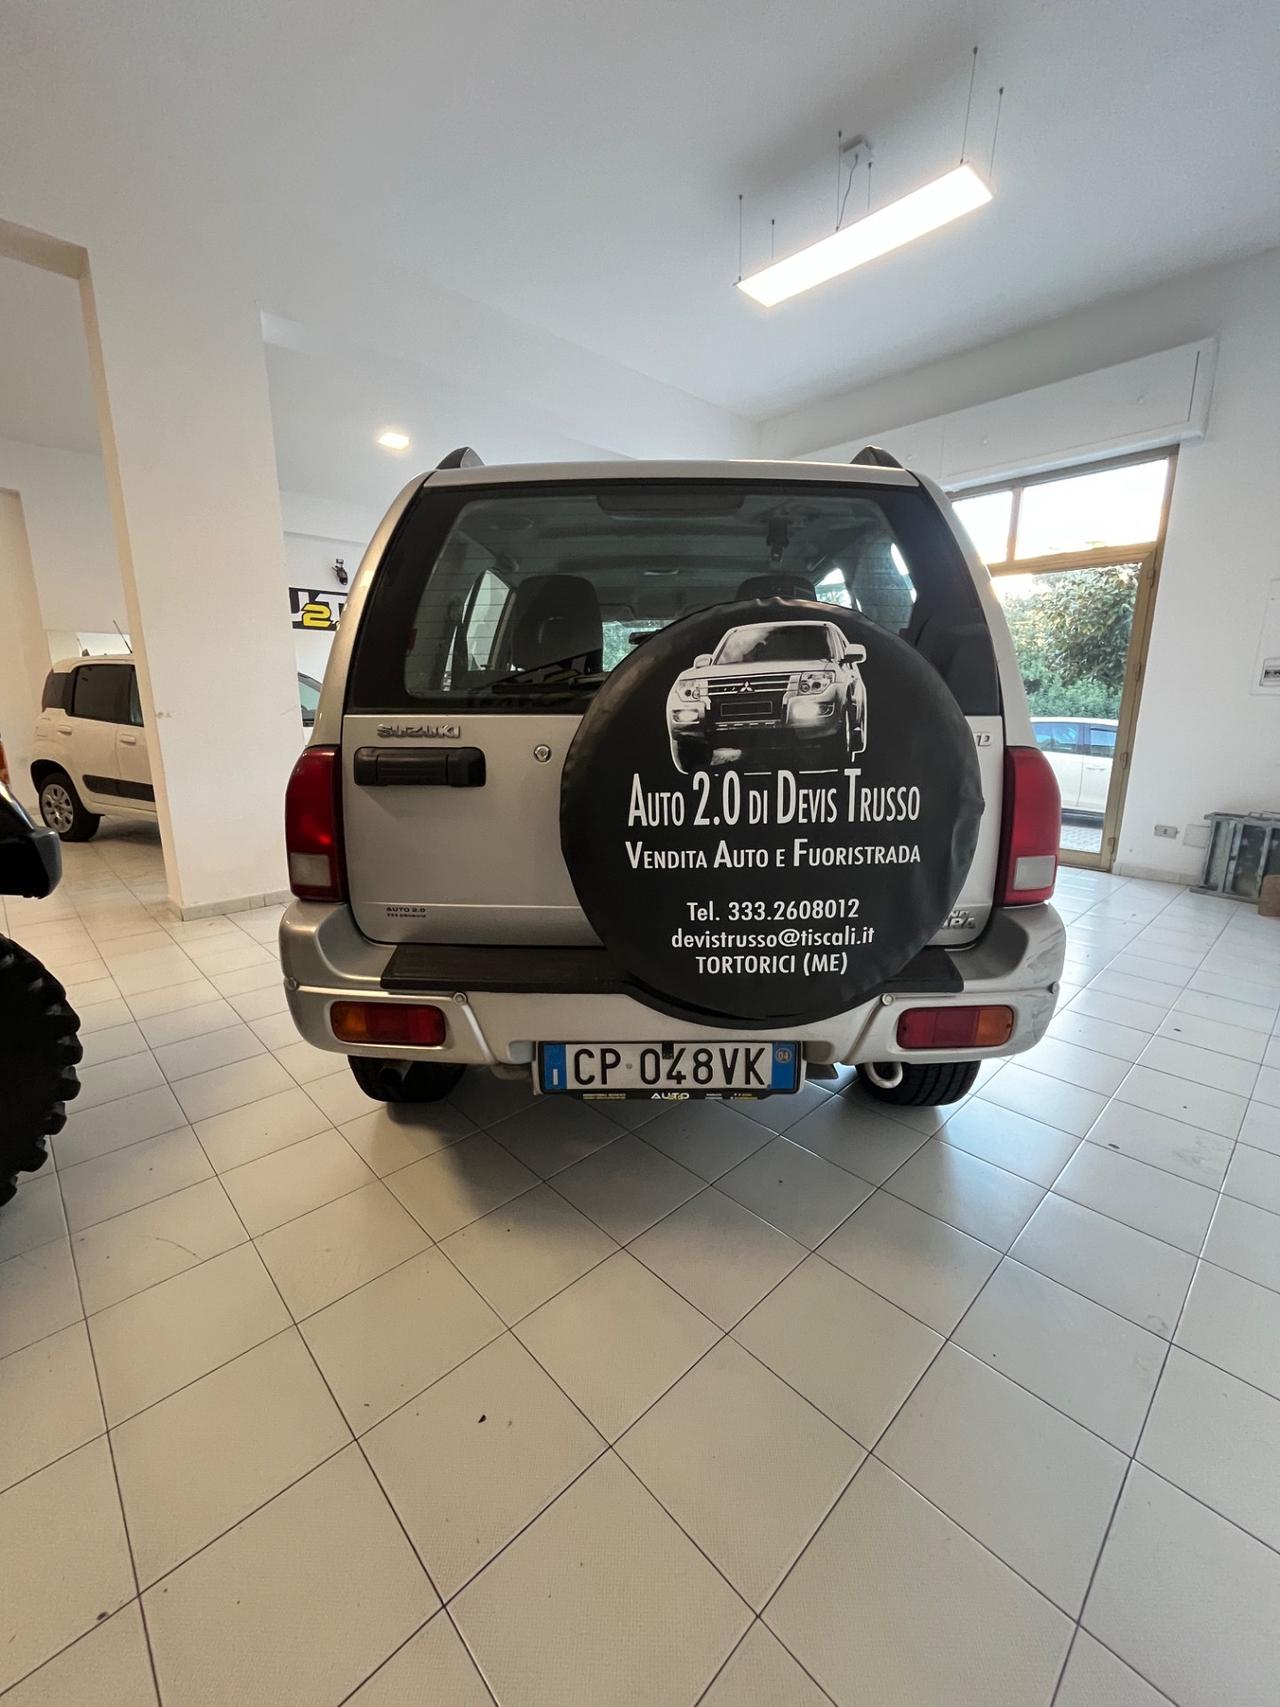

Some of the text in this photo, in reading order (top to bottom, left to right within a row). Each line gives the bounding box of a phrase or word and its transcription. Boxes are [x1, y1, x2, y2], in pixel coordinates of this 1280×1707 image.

[377, 724, 461, 738] SUZUKI
[627, 768, 921, 827] AUTO 2.0 DI DEVIS TRUSSO
[625, 838, 921, 869] VENDITA AUTO E FUORISTRADA
[686, 898, 860, 922] Tel. 333.2608012
[671, 925, 875, 950] devistrusso@tiscali.it
[695, 951, 848, 977] TORTORICI (ME)
[574, 1046, 766, 1086] CP 048VK
[650, 1092, 690, 1100] AUTO
